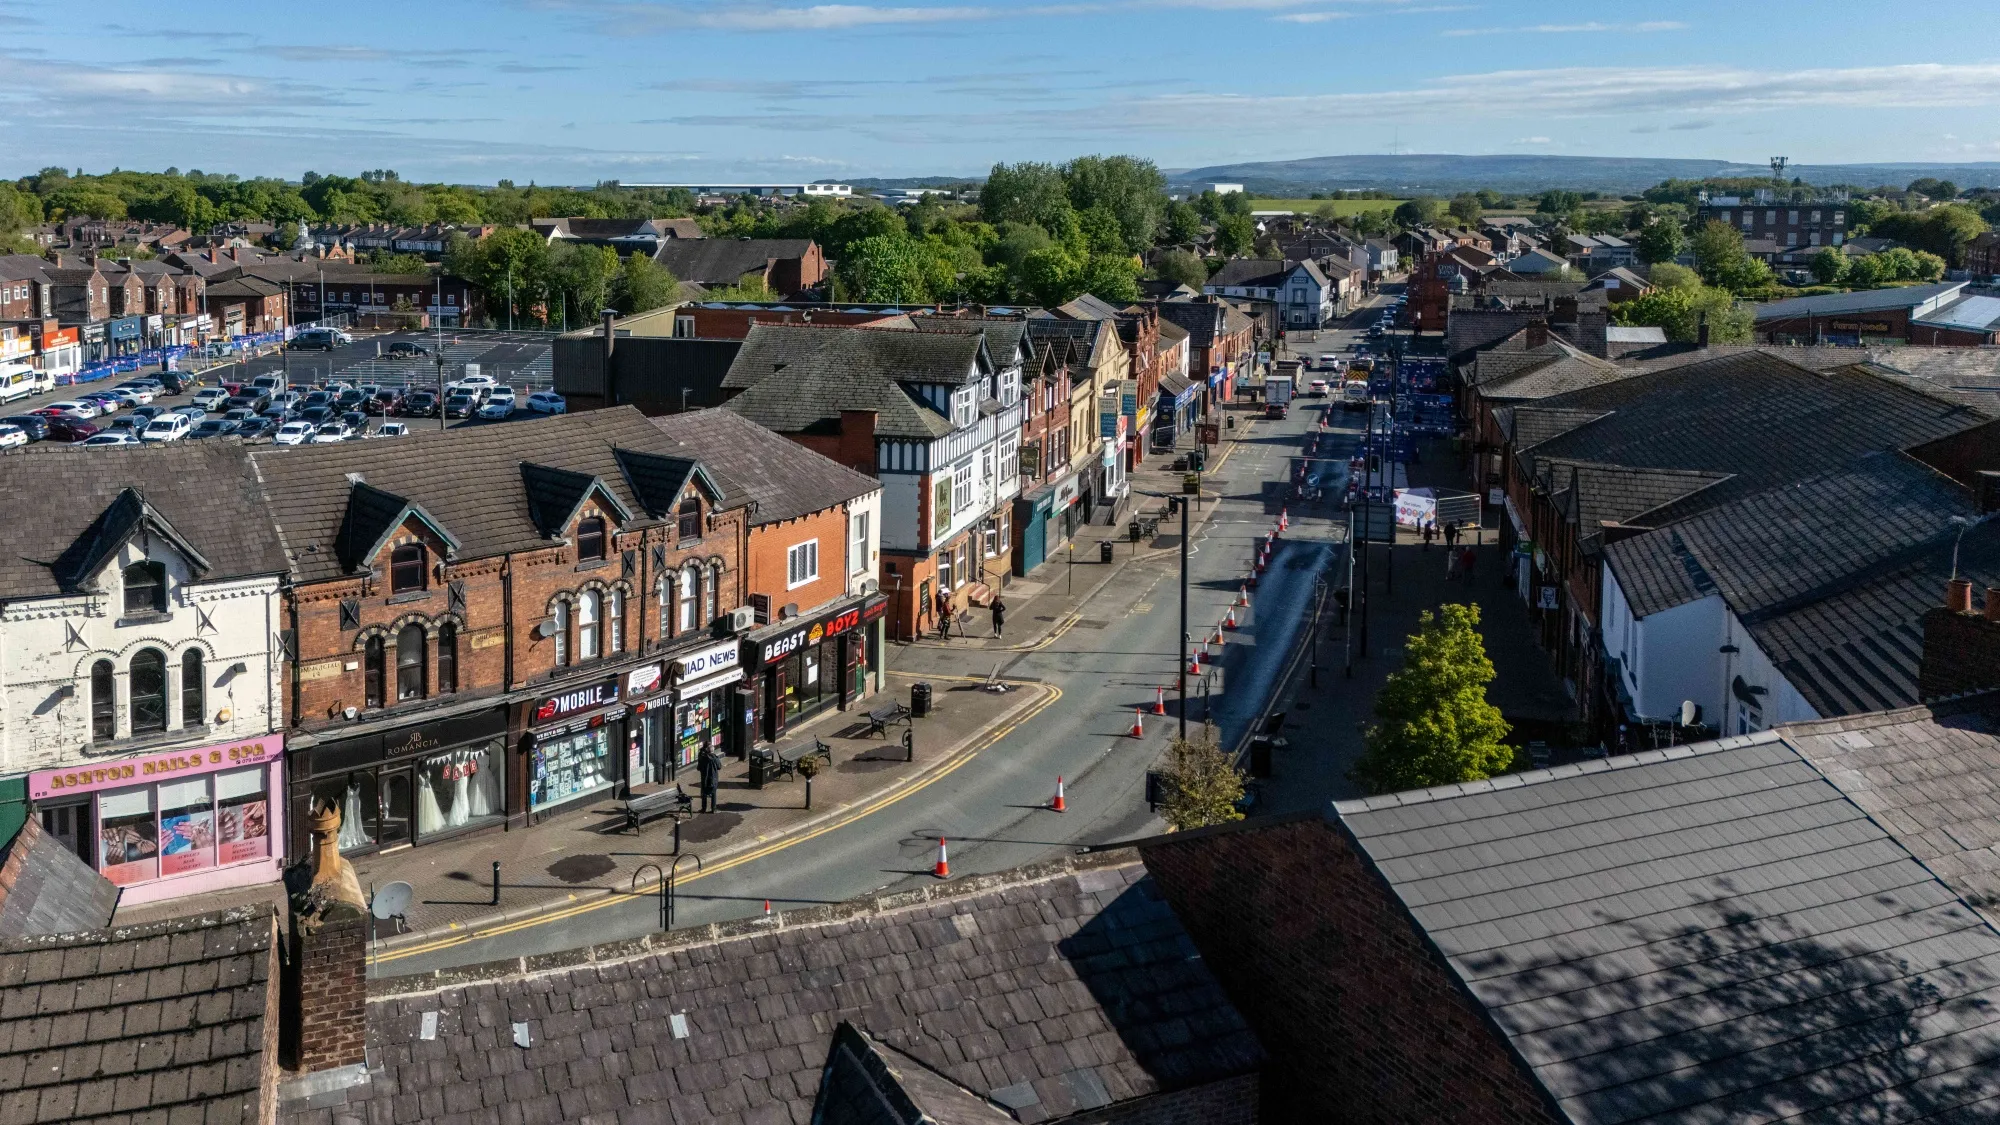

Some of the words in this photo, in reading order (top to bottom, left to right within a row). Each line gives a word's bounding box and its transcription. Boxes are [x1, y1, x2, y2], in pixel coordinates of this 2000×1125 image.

[765, 630, 806, 661] BEAST
[826, 610, 859, 637] BOYZ
[710, 649, 736, 667] NEWS
[560, 686, 602, 713] MOBILE
[648, 696, 670, 710] MOBILE
[388, 739, 439, 756] ROMANCIA
[52, 765, 135, 789] ASHTON
[142, 753, 202, 775] NAILS
[228, 743, 266, 761] SPA
[445, 760, 477, 779] SALE
